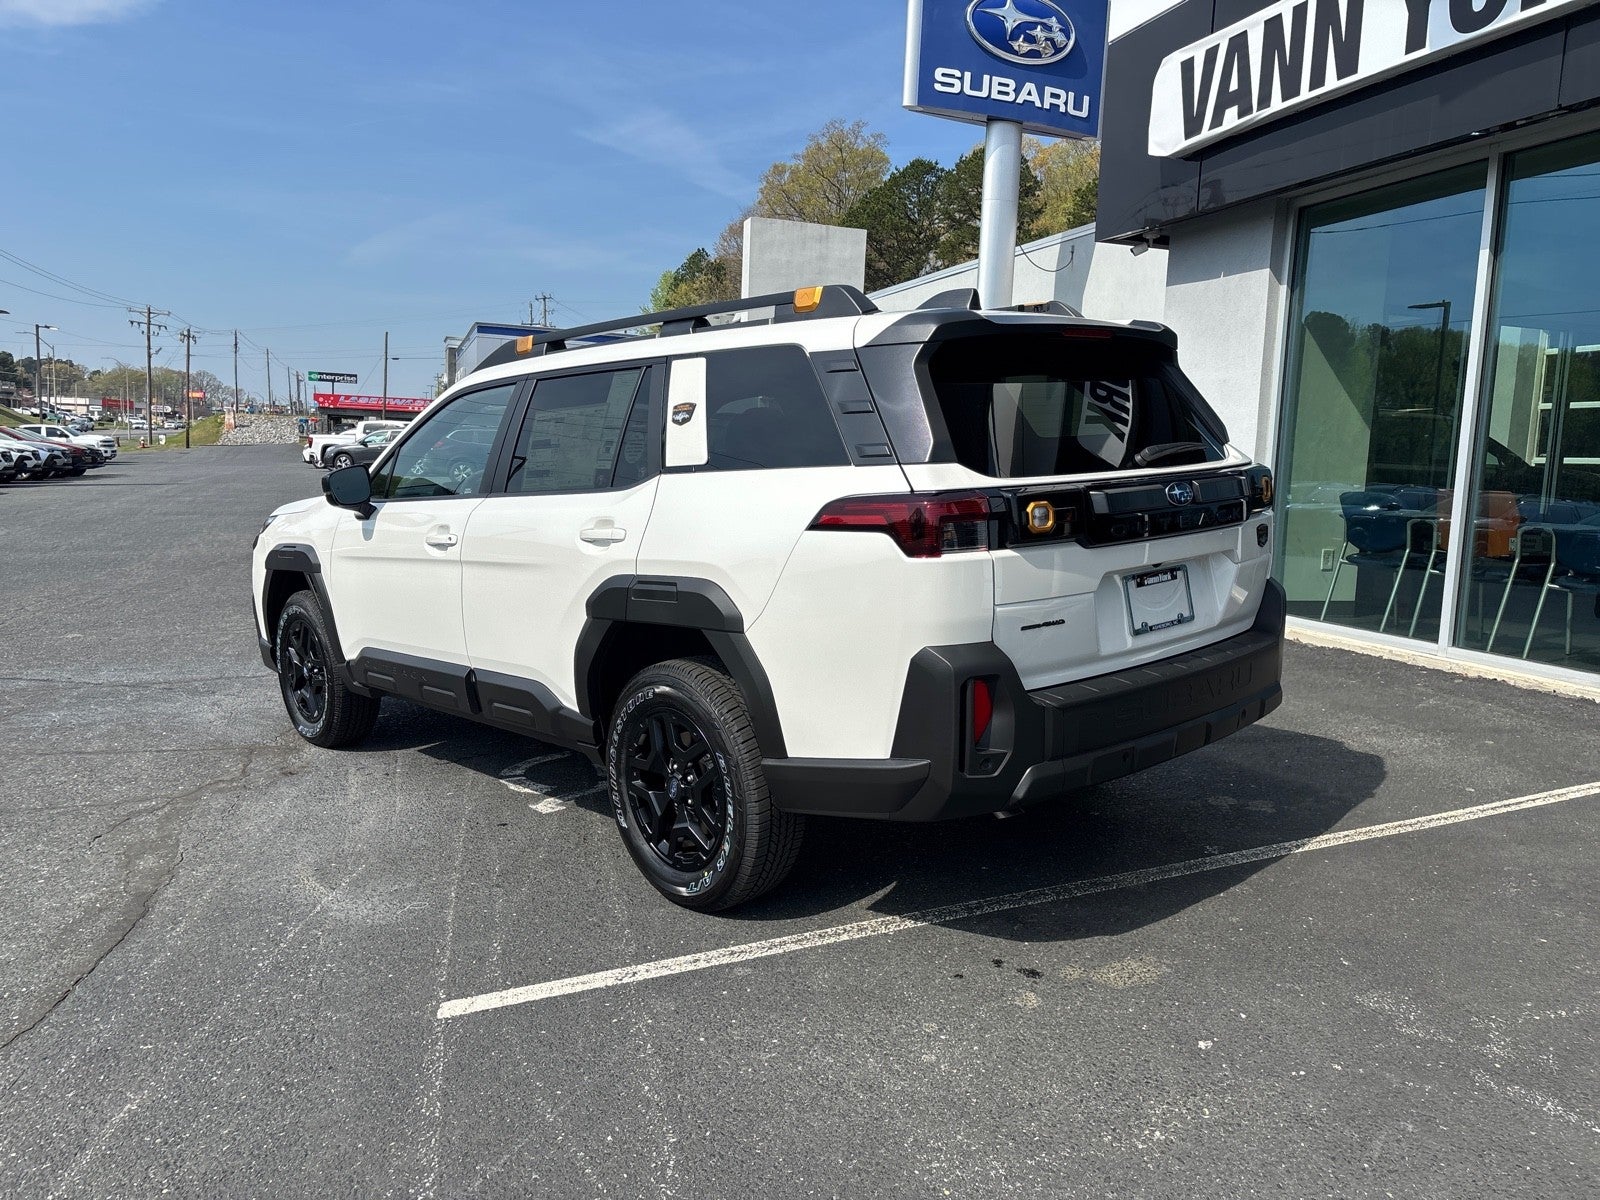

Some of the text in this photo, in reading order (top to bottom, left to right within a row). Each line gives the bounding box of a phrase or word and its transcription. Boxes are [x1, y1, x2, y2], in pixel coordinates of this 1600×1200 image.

[933, 67, 1090, 118] SUBARU
[1180, 0, 1365, 141] VANN
[309, 373, 357, 382] enterprise
